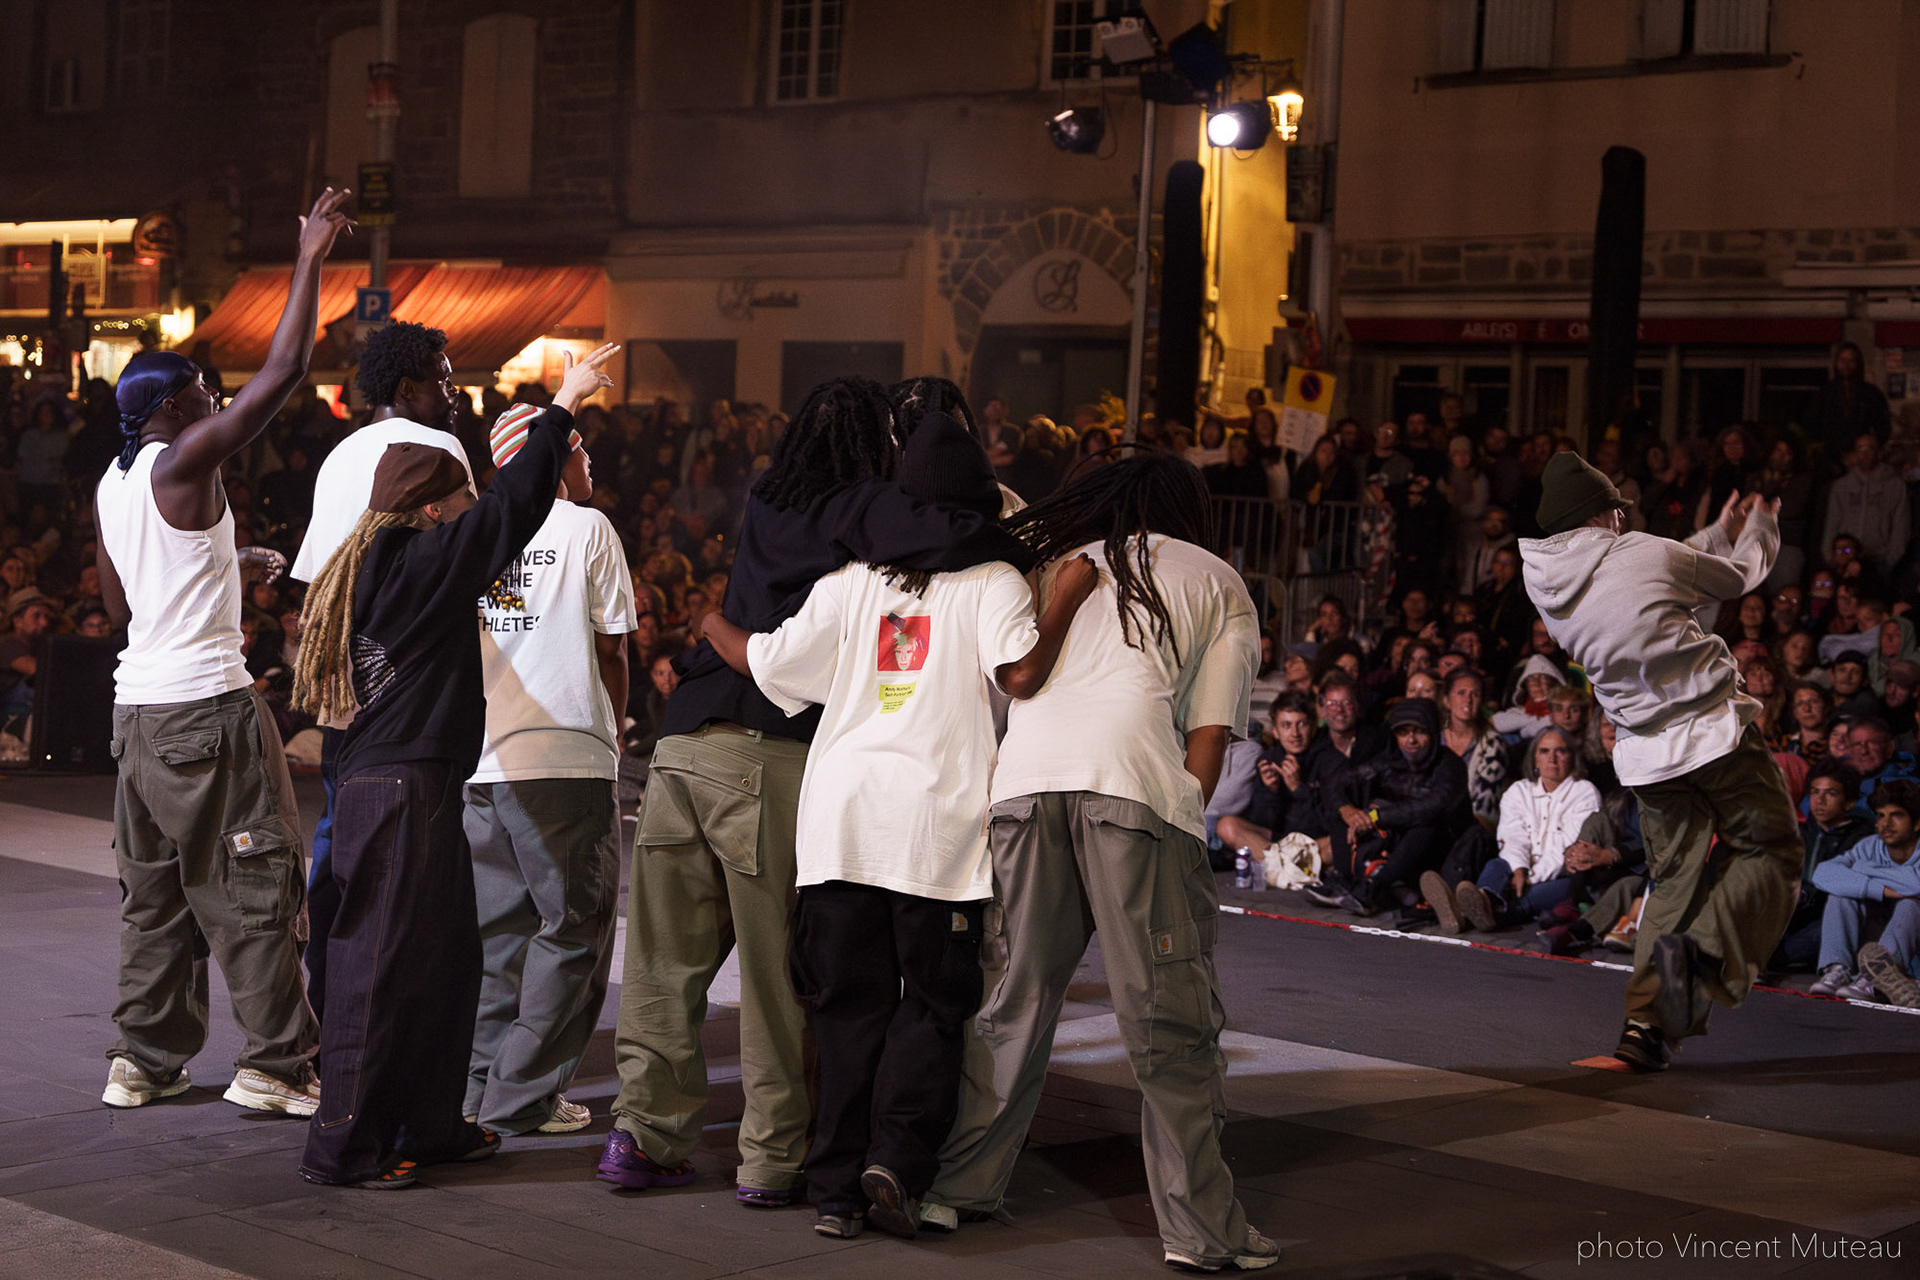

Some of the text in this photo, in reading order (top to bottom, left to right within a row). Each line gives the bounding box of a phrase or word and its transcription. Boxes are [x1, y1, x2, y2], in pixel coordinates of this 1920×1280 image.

[364, 293, 381, 317] P
[522, 549, 556, 566] VES
[477, 615, 540, 632] HLETE
